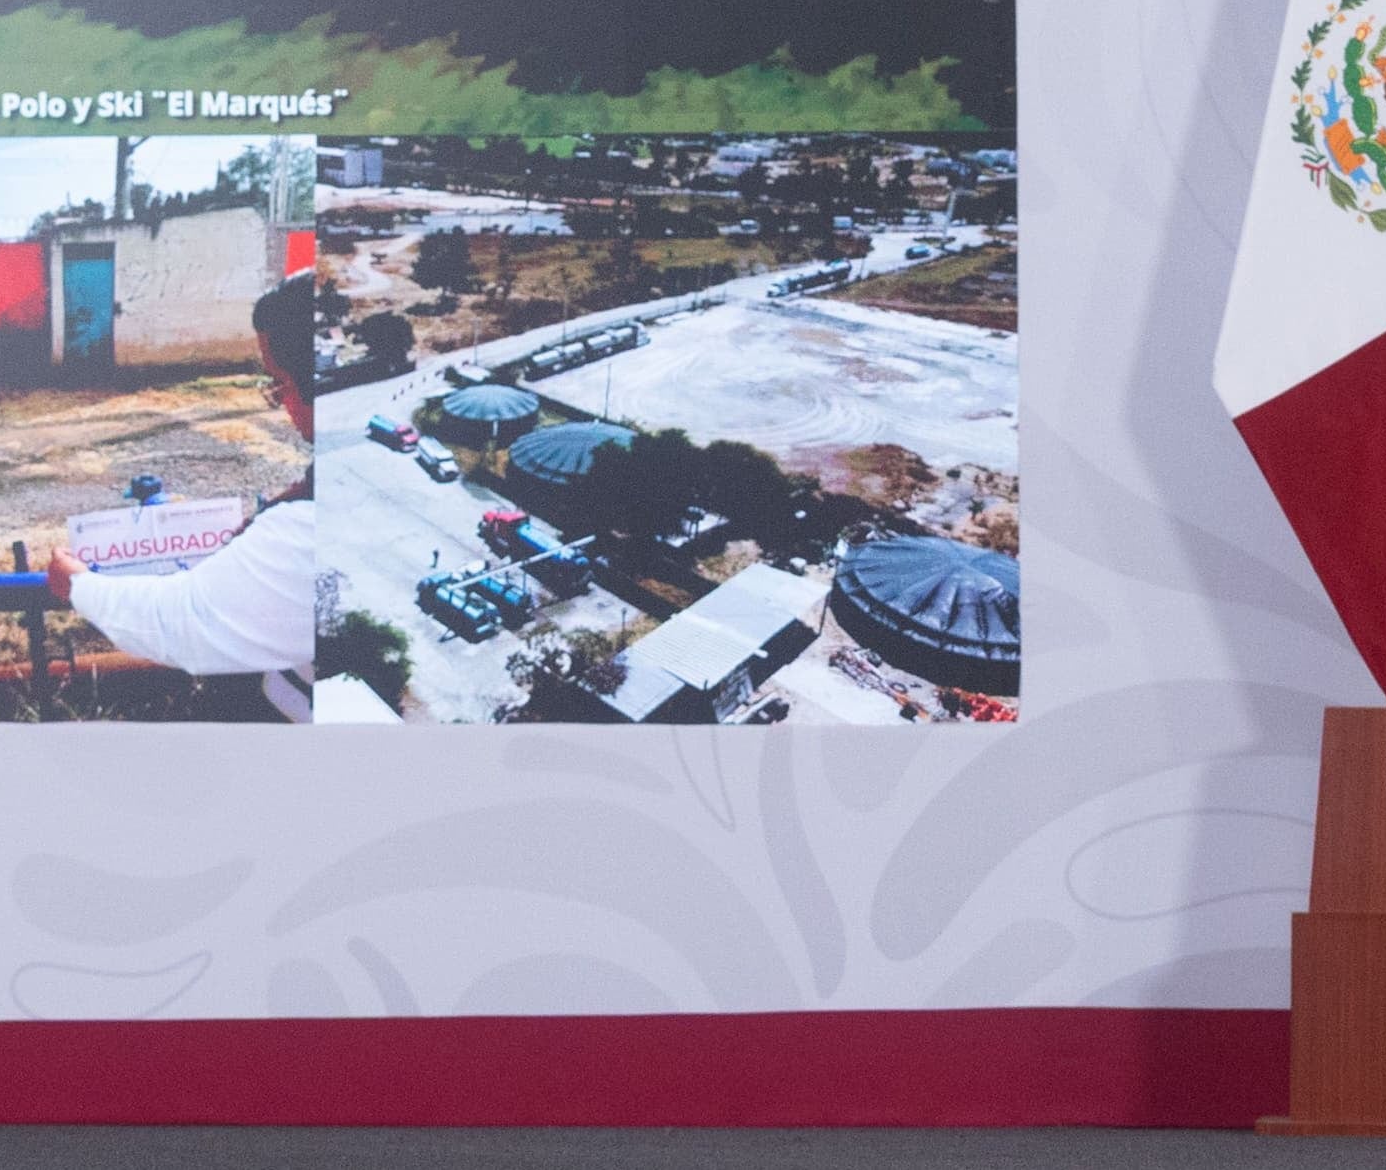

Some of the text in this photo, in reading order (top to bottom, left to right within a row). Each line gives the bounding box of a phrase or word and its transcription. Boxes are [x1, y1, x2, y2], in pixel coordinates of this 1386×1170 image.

[2, 92, 66, 118] Polo
[73, 96, 93, 125] y
[98, 90, 143, 117] Ski
[77, 528, 234, 564] CLAUSURADO
